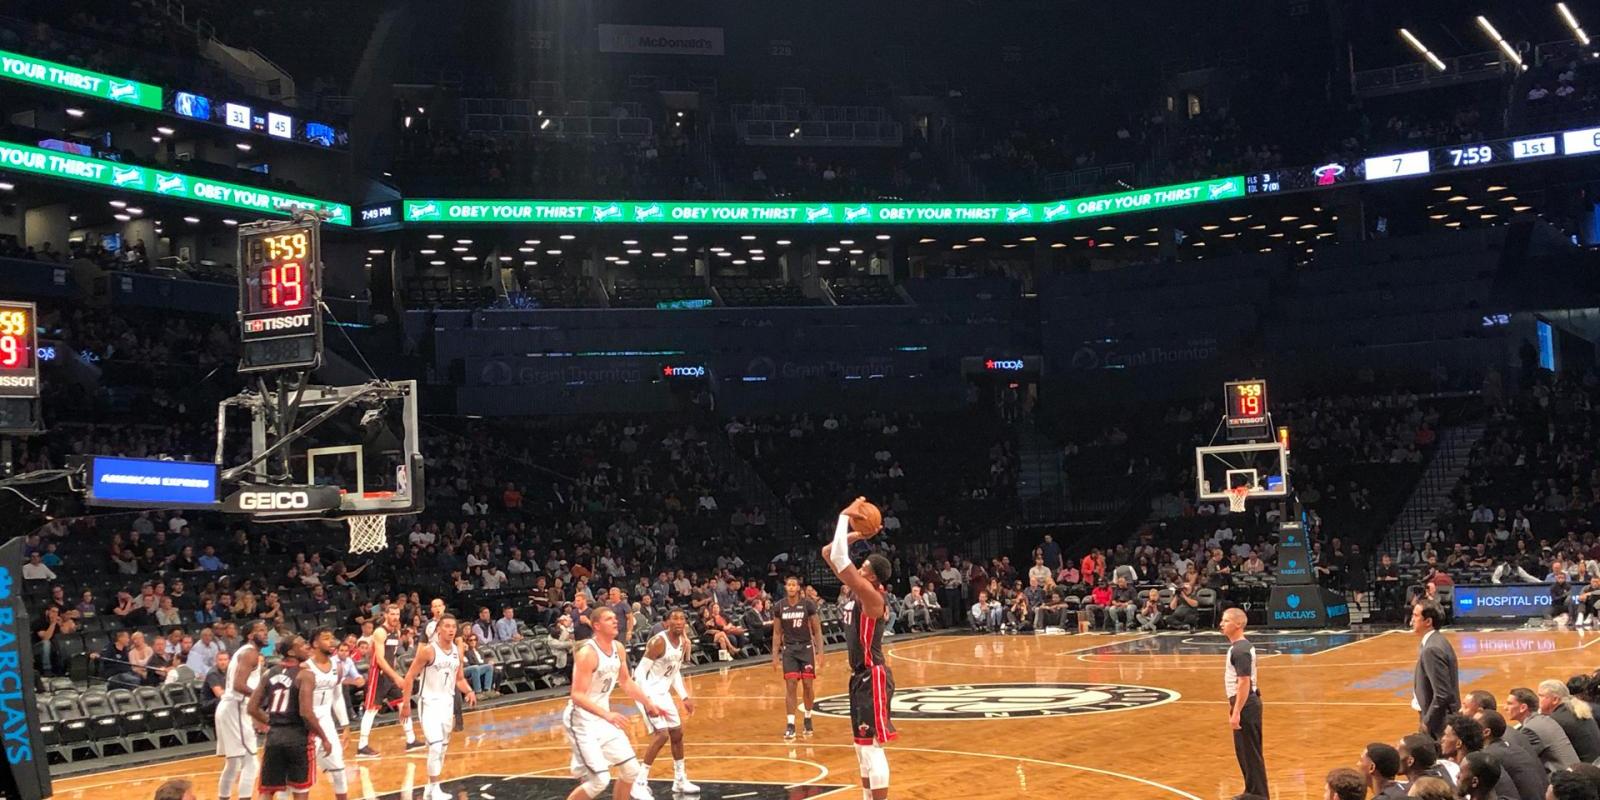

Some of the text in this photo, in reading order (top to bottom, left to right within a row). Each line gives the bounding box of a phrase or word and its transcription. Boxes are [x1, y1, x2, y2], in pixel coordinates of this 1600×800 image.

[2, 57, 46, 80] YOUR
[48, 68, 104, 92] THIRST
[232, 111, 244, 124] 31
[274, 120, 286, 133] 45
[1522, 142, 1546, 154] 1st
[1450, 146, 1492, 166] 7:59
[0, 148, 46, 169] YOUR
[49, 155, 107, 180] THIRST
[1392, 158, 1403, 173] 7
[194, 182, 231, 201] OBEY
[233, 188, 271, 209] YOUR
[1077, 186, 1202, 214] OBEY YOUR THIRST
[361, 206, 392, 220] 7:49 PM
[449, 205, 585, 218] OBEY YOUR THIRST
[672, 207, 798, 220] OBEY YOUR THIRST
[879, 207, 1002, 220] OBEY YOUR THIRST
[264, 233, 307, 260] 7:59
[270, 263, 301, 306] 19
[264, 314, 312, 330] TISSOT
[1237, 384, 1261, 396] 7:59
[1241, 396, 1259, 415] 19
[239, 491, 309, 510] GEICO
[1477, 595, 1531, 606] HOSPITAL
[782, 612, 805, 620] MIAMI
[843, 611, 852, 625] 21
[1274, 610, 1317, 620] BARCLAYS
[793, 619, 802, 628] 16
[444, 671, 450, 685] 7
[270, 688, 290, 713] 11
[320, 691, 326, 706] 1
